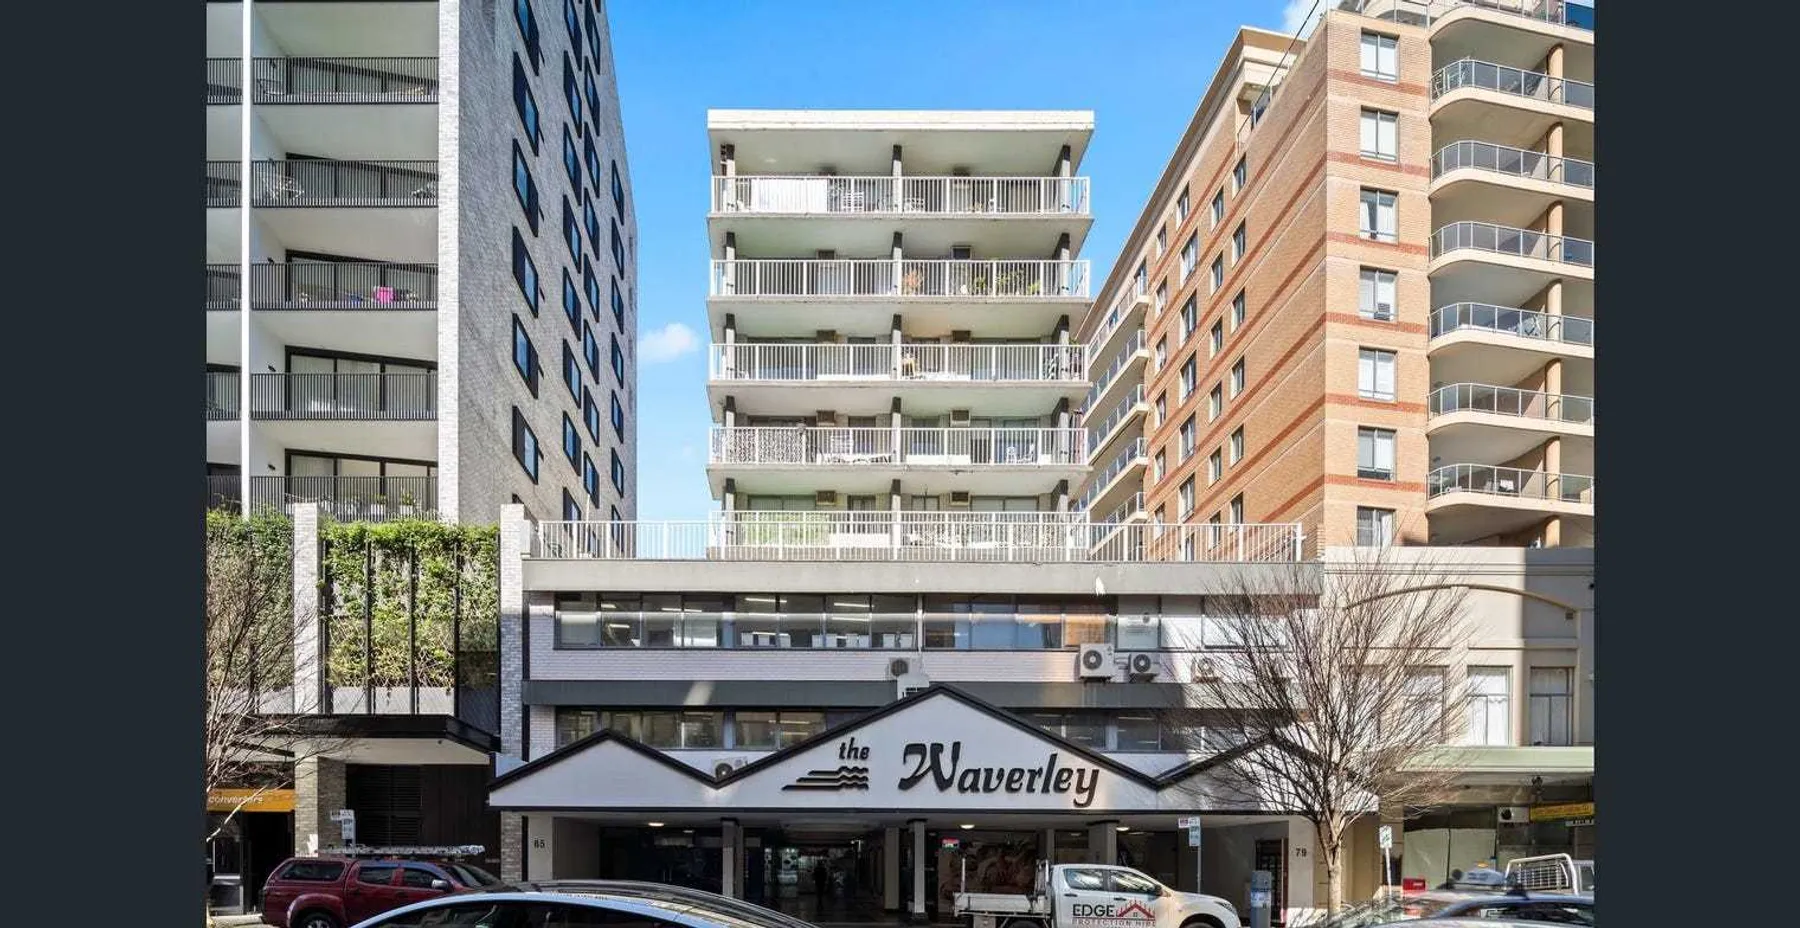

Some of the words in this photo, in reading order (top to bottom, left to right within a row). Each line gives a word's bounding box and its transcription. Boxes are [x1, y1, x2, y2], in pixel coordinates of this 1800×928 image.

[838, 737, 870, 760] the
[898, 741, 1100, 808] Waverley
[1295, 847, 1307, 857] 79
[1072, 904, 1115, 917] EDGE
